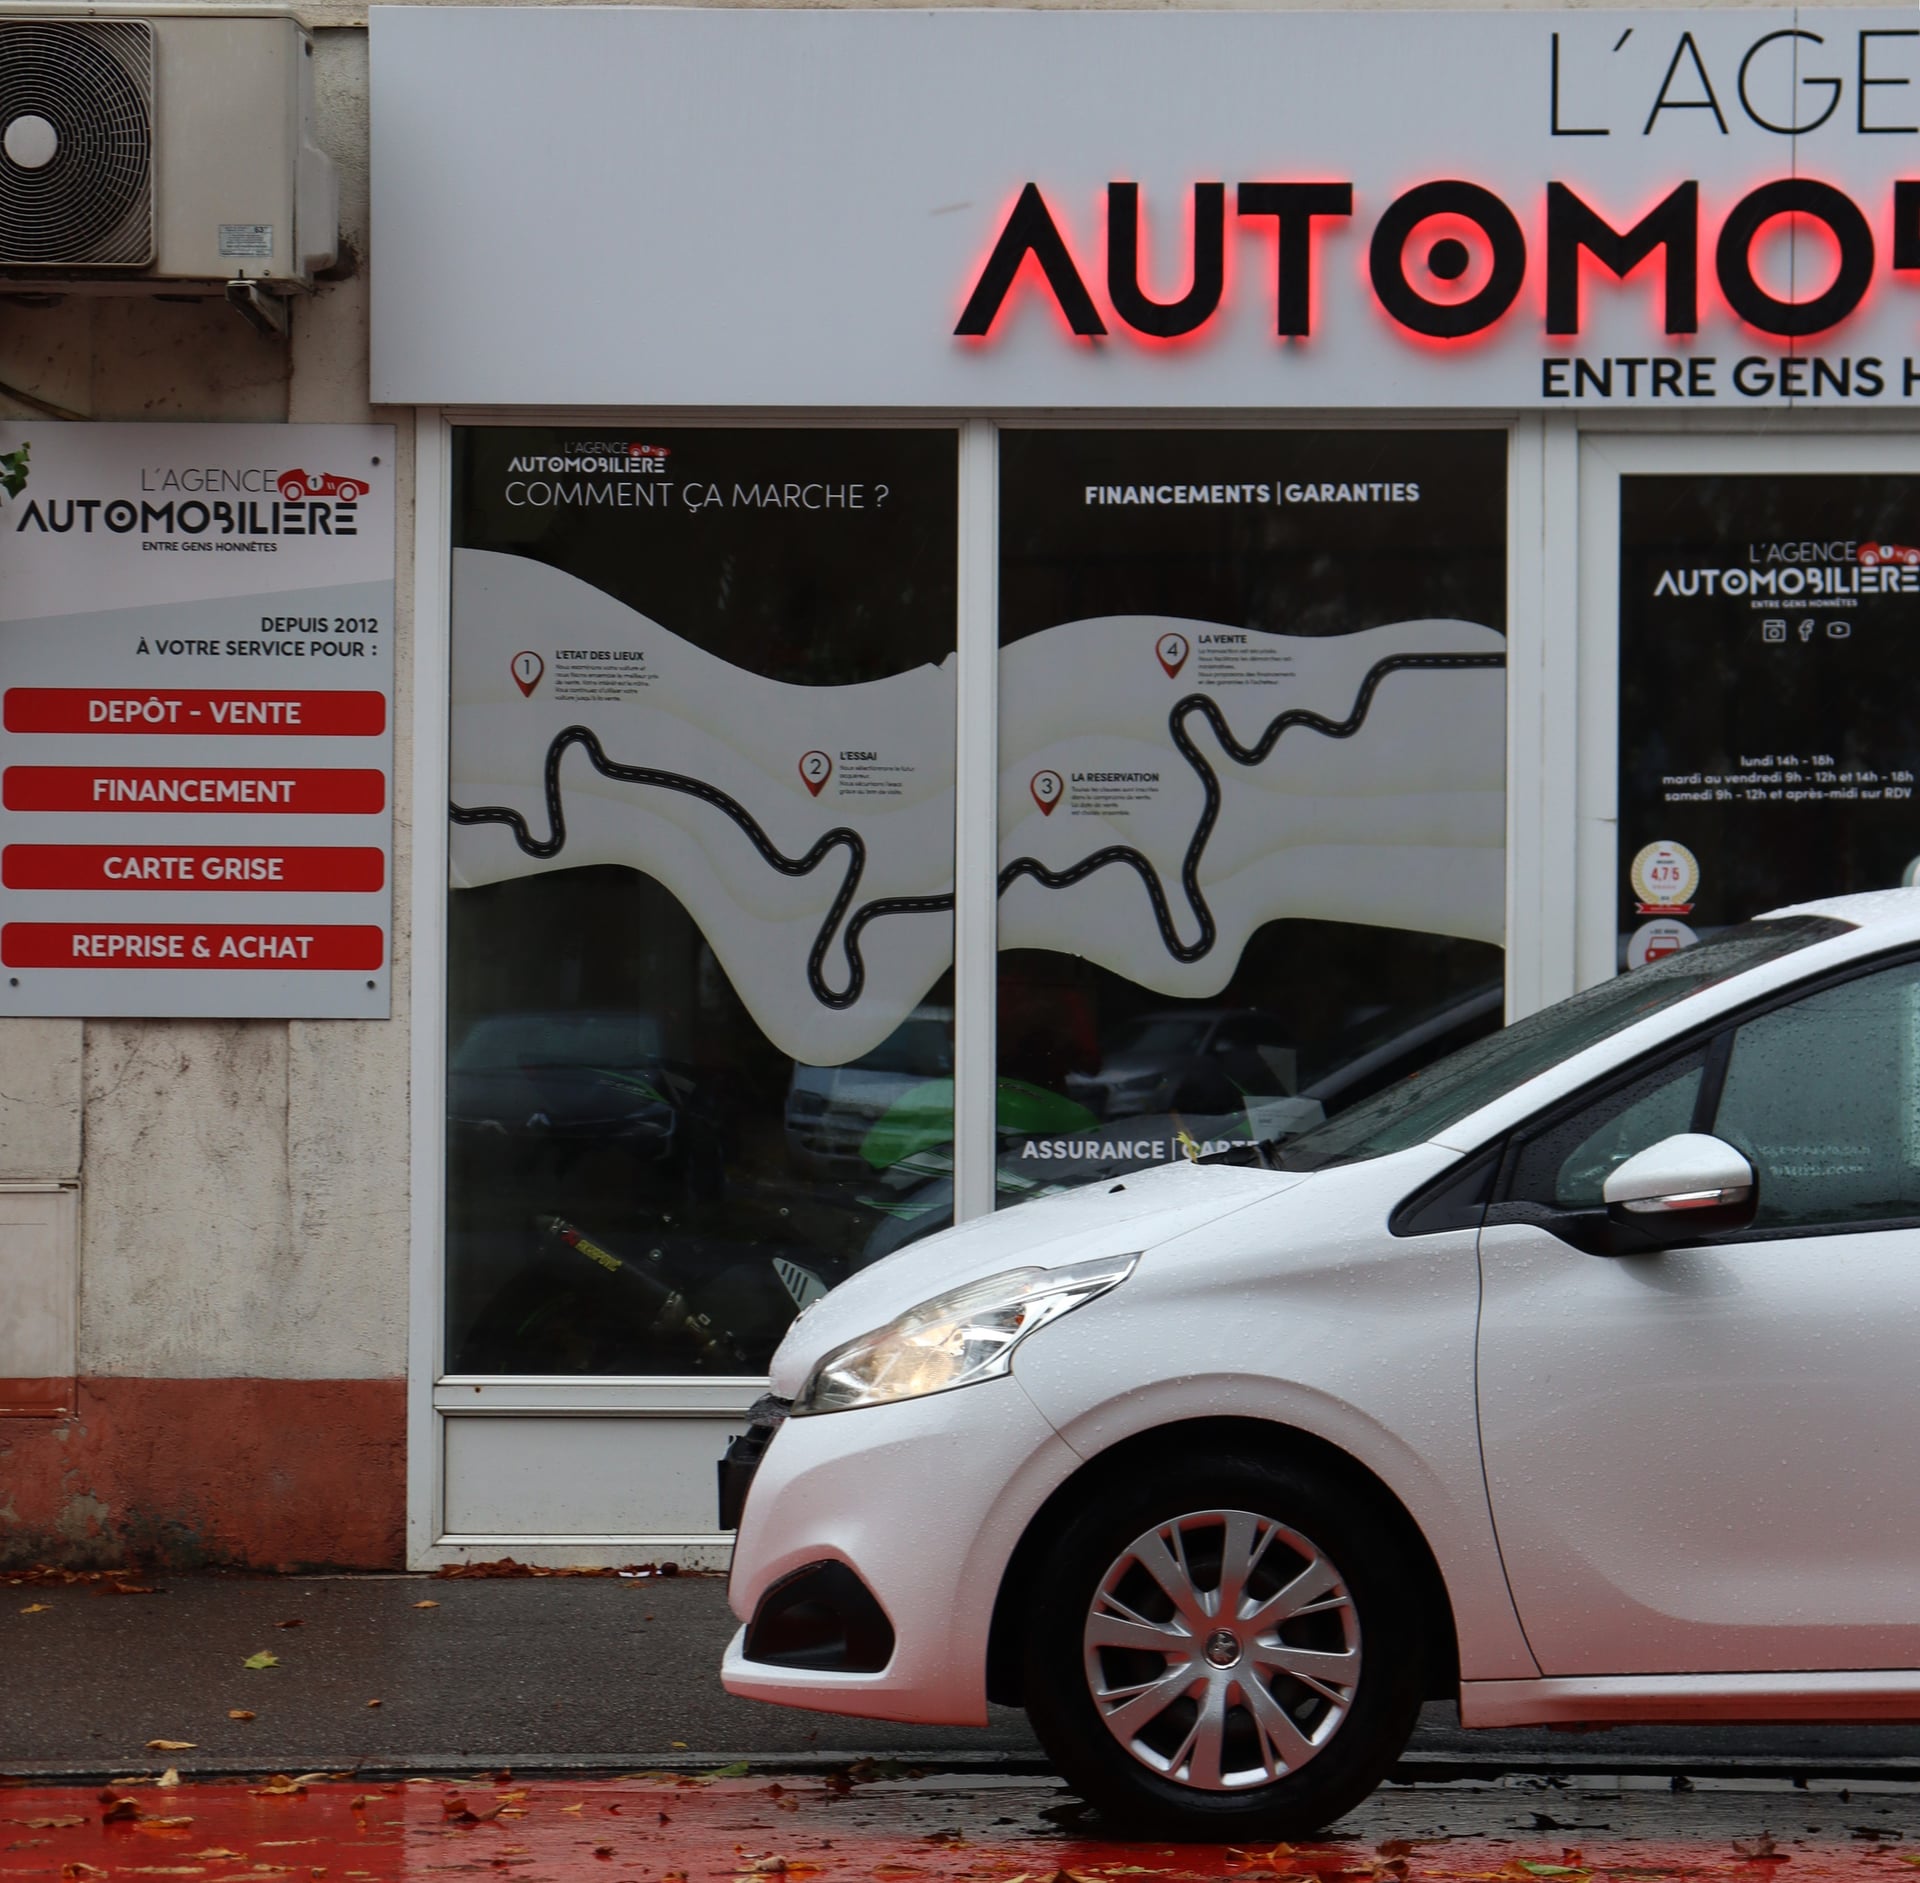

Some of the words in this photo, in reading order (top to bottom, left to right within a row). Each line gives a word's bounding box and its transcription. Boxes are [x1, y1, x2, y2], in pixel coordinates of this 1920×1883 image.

[1542, 358, 1716, 398] ENTRE
[1732, 356, 1884, 398] GENS
[565, 442, 628, 455] L'AGENCE
[508, 457, 664, 473] AUTOMOBILIERE
[142, 468, 277, 492] L'AGENCE
[505, 482, 673, 507] COMMENT
[682, 484, 722, 513] ÇA
[732, 483, 864, 509] MARCHE
[874, 484, 889, 508] ?
[1085, 485, 1270, 504] FINANCEMENTS
[1285, 483, 1420, 502] GARANTIES
[16, 500, 357, 535] AUTOMOBILIERE
[142, 542, 179, 551] ENTRE
[182, 542, 213, 551] GENS
[216, 539, 277, 552] HONNÊTES
[1750, 542, 1857, 563] L'AGENCE
[1653, 566, 1920, 596] AUTOMOBILIERE
[261, 618, 328, 633] DEPUIS
[334, 618, 379, 633] 2012
[136, 637, 149, 655] À
[155, 640, 220, 655] VOTRE
[226, 640, 305, 656] SERVICE
[310, 641, 365, 656] POUR
[1199, 635, 1211, 643] LA
[1214, 635, 1248, 643] VENTE
[556, 650, 588, 660] L'ETAT
[590, 651, 611, 660] DES
[613, 651, 644, 661] LIEUX
[1167, 642, 1178, 656] 4
[524, 659, 530, 675] 1
[89, 697, 182, 723] DEPÔT
[209, 701, 301, 724] VENTE
[840, 751, 877, 761] L'ESSAI
[1740, 755, 1774, 767] lundi
[1777, 756, 1799, 766] 14h
[1812, 755, 1834, 766] 18h
[811, 759, 821, 774] 2
[1072, 773, 1085, 782] LA
[1087, 773, 1159, 782] RESERVATION
[1663, 773, 1701, 785] mardi
[1704, 776, 1721, 785] au
[1724, 772, 1783, 784] vendredi
[1785, 772, 1802, 783] 9h
[1815, 772, 1836, 783] 12h
[1839, 772, 1853, 783] et
[1856, 771, 1878, 782] 14h
[1892, 771, 1914, 782] 18h
[93, 779, 296, 803] FINANCEMENT
[1042, 778, 1053, 794] 3
[1665, 790, 1713, 802] samedi
[1715, 790, 1732, 800] 9h
[1746, 789, 1767, 800] 12h
[1770, 789, 1783, 799] et
[1786, 787, 1858, 802] après-midi
[1861, 790, 1881, 799] sur
[1884, 788, 1911, 798] RDV
[103, 857, 194, 880] CARTE
[201, 858, 284, 880] GRISE
[72, 935, 184, 957] REPRISE
[191, 937, 210, 958] &
[219, 936, 314, 959] ACHAT
[1022, 1140, 1165, 1160] ASSURANCE
